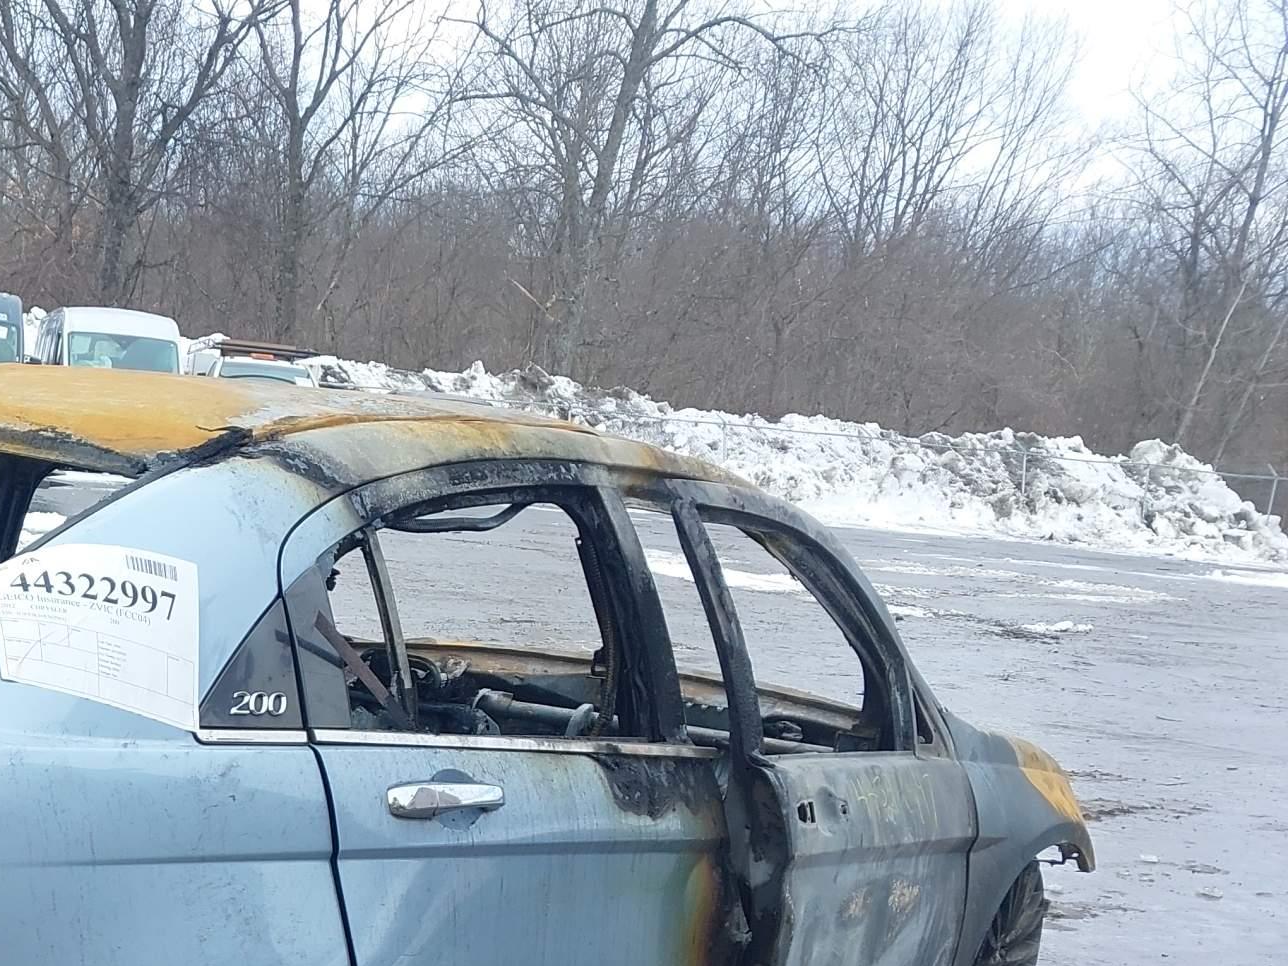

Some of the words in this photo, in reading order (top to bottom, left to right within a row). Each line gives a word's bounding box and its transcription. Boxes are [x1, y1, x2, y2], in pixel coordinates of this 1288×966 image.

[10, 570, 177, 621] 44322997
[37, 595, 81, 607] Insurance
[230, 691, 287, 716] 200
